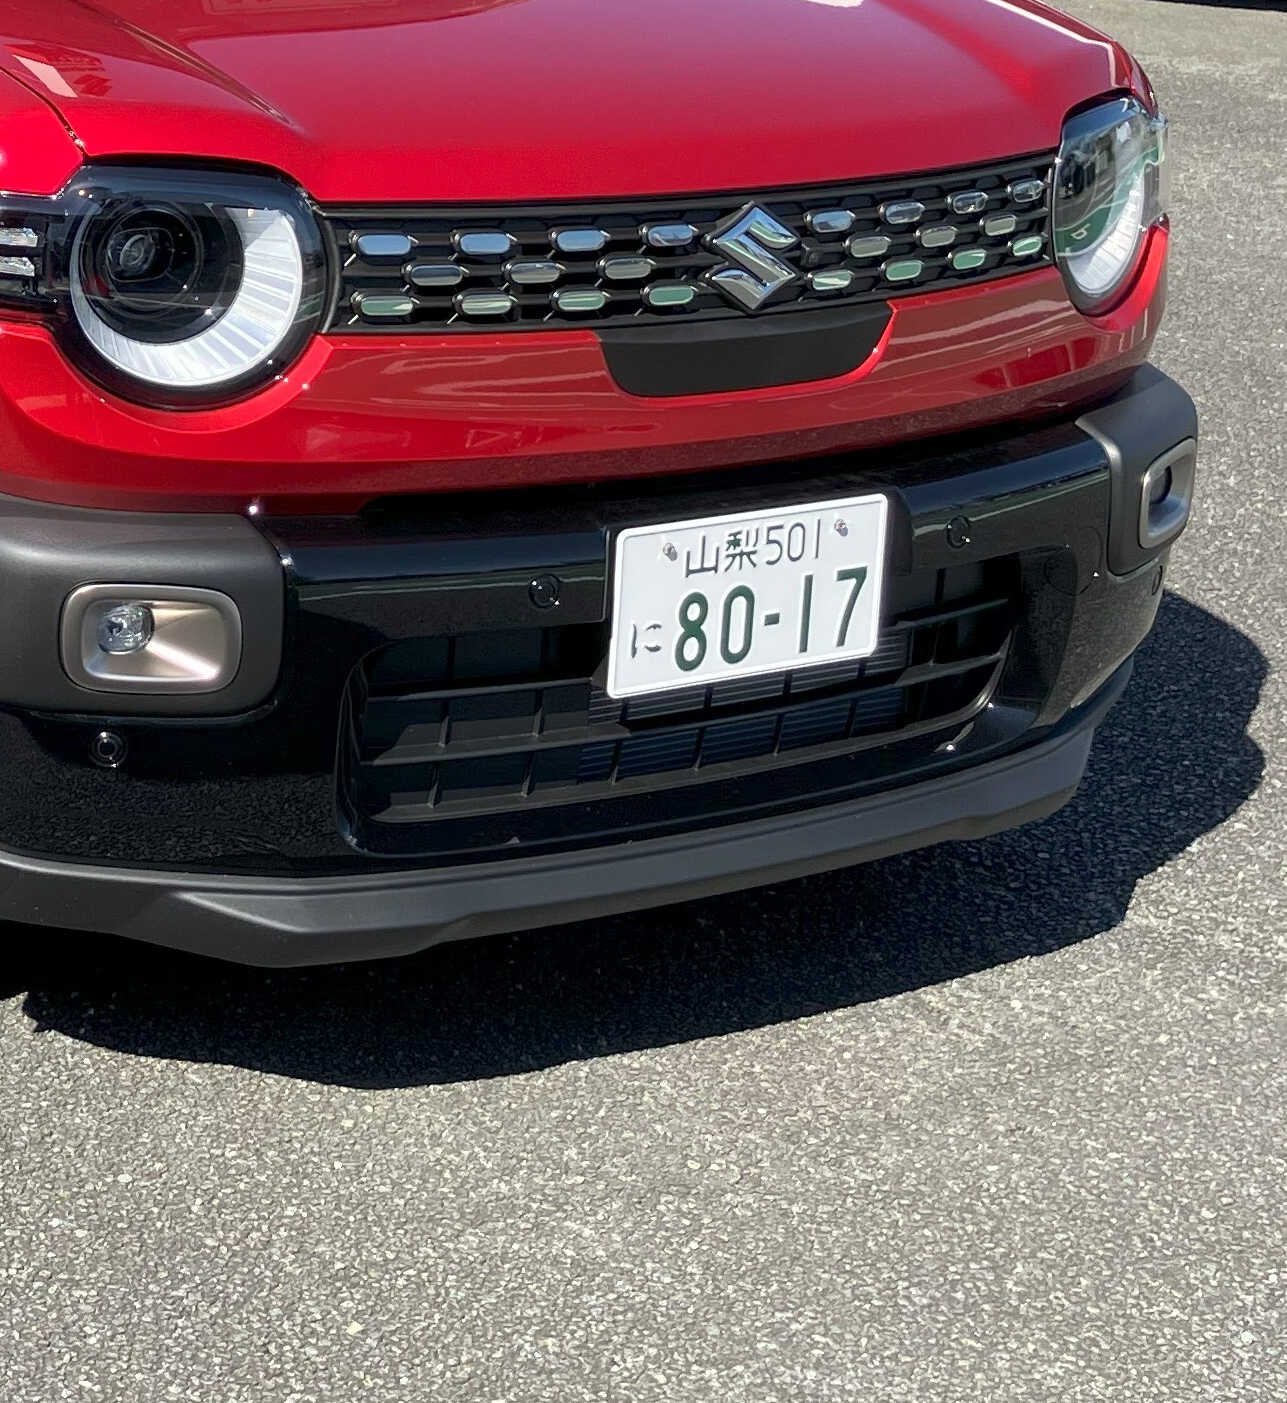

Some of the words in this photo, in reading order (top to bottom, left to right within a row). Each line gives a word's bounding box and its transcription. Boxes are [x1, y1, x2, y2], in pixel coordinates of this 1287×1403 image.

[684, 517, 821, 578] 山梨501
[630, 623, 663, 659] に
[674, 565, 868, 672] 80-17
